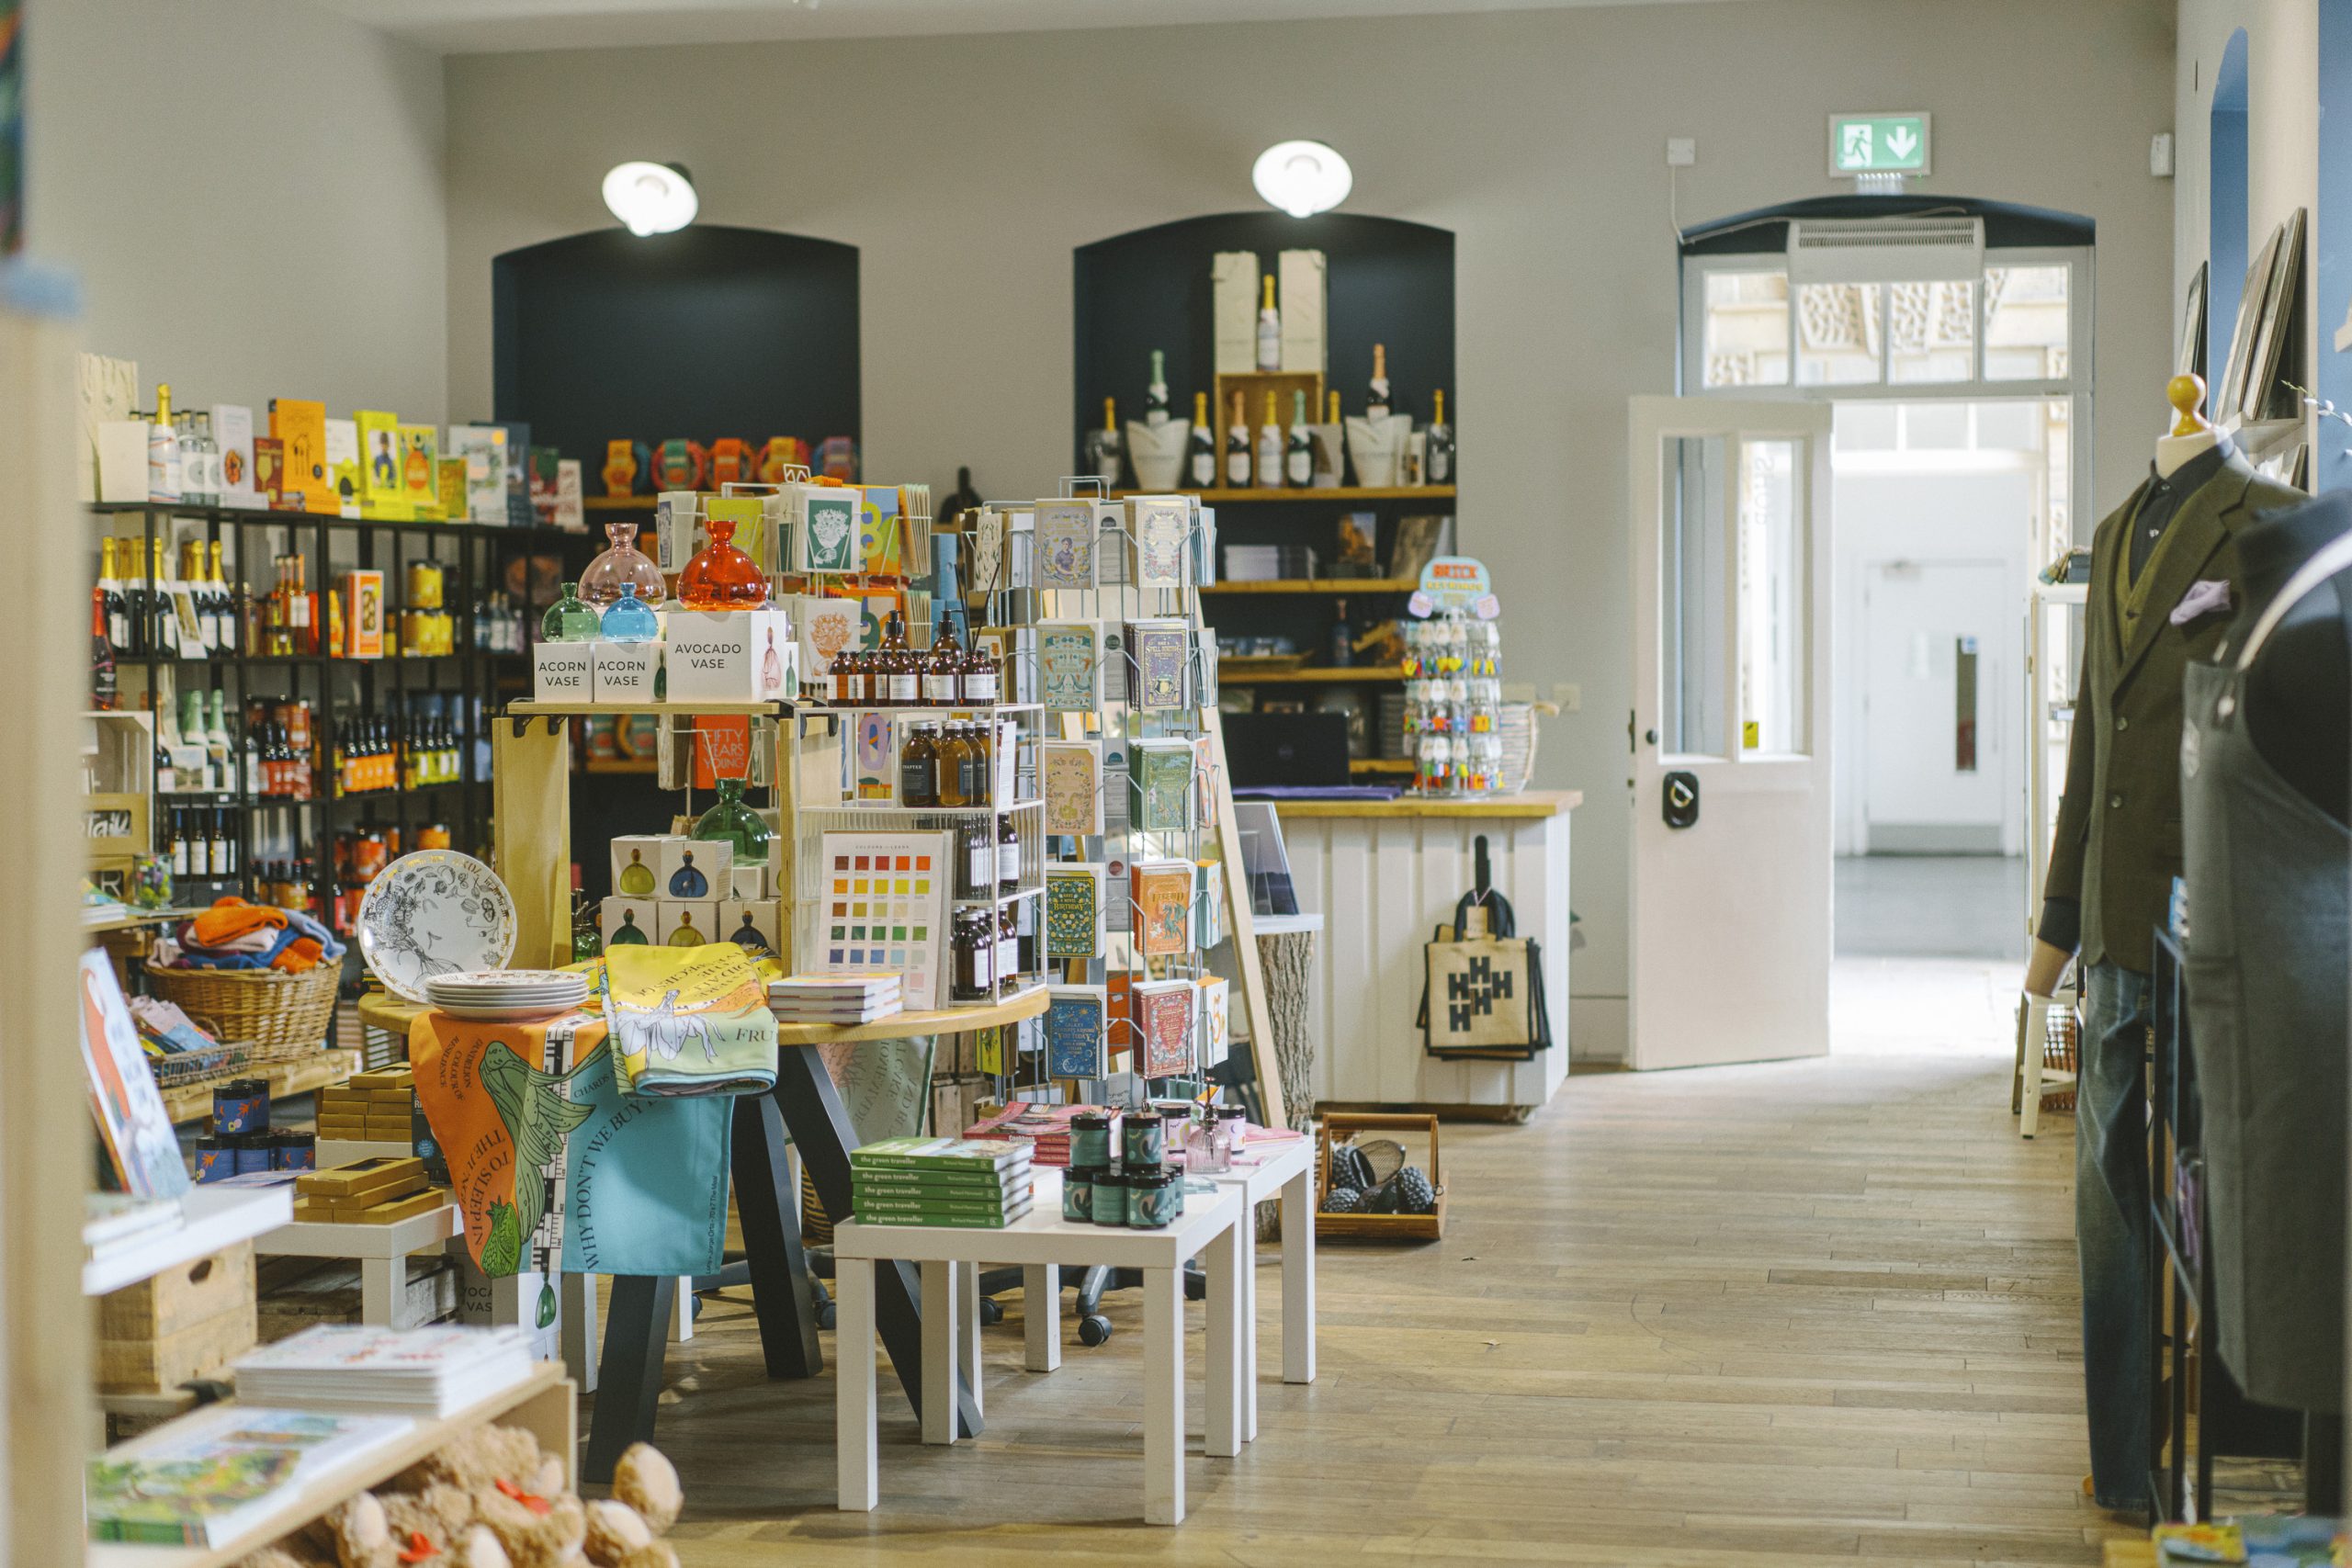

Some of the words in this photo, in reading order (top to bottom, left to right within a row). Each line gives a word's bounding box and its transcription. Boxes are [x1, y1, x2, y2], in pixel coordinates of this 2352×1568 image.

[1432, 564, 1477, 579] BRICK
[674, 643, 741, 654] AVOCADO
[538, 661, 586, 671] ACORN
[597, 660, 646, 671] ACORN
[691, 659, 725, 669] VASE
[545, 676, 580, 686] VASE
[604, 676, 639, 686] VASE
[702, 728, 744, 742] FIFTY
[703, 743, 744, 758] YEARS
[703, 758, 744, 769] YOUNG
[736, 1028, 779, 1043] FRU
[573, 1073, 610, 1099] CHARDS
[610, 1104, 642, 1133] BUY
[476, 1130, 505, 1159] THE
[587, 1125, 613, 1152] WE
[489, 1150, 510, 1171] TO
[470, 1168, 492, 1222] SLEEP
[576, 1155, 597, 1221] DON'T
[876, 1202, 893, 1211] green
[471, 1224, 483, 1246] IN
[576, 1224, 599, 1270] WHY
